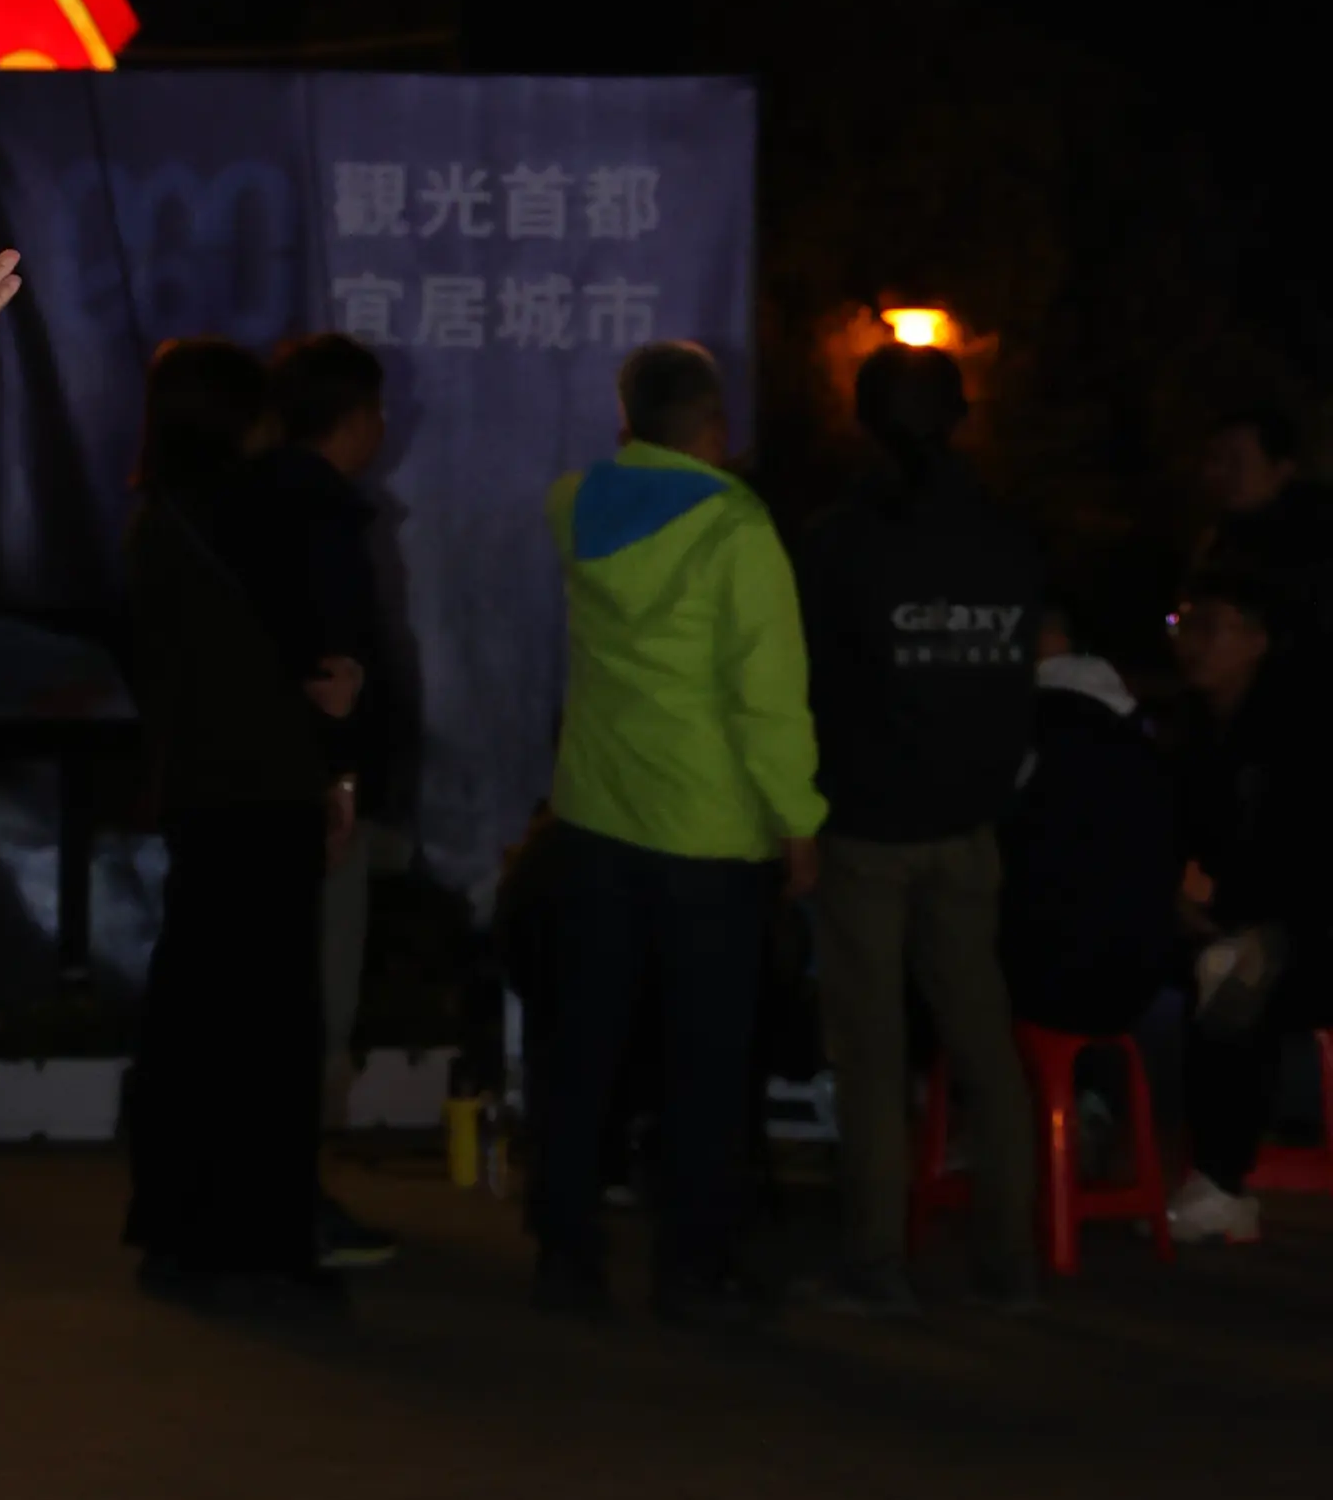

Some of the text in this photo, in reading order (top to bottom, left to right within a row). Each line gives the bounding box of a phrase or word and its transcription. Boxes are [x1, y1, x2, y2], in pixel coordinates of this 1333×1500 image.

[332, 161, 661, 241] 觀光首都
[330, 273, 660, 349] 宜居城市
